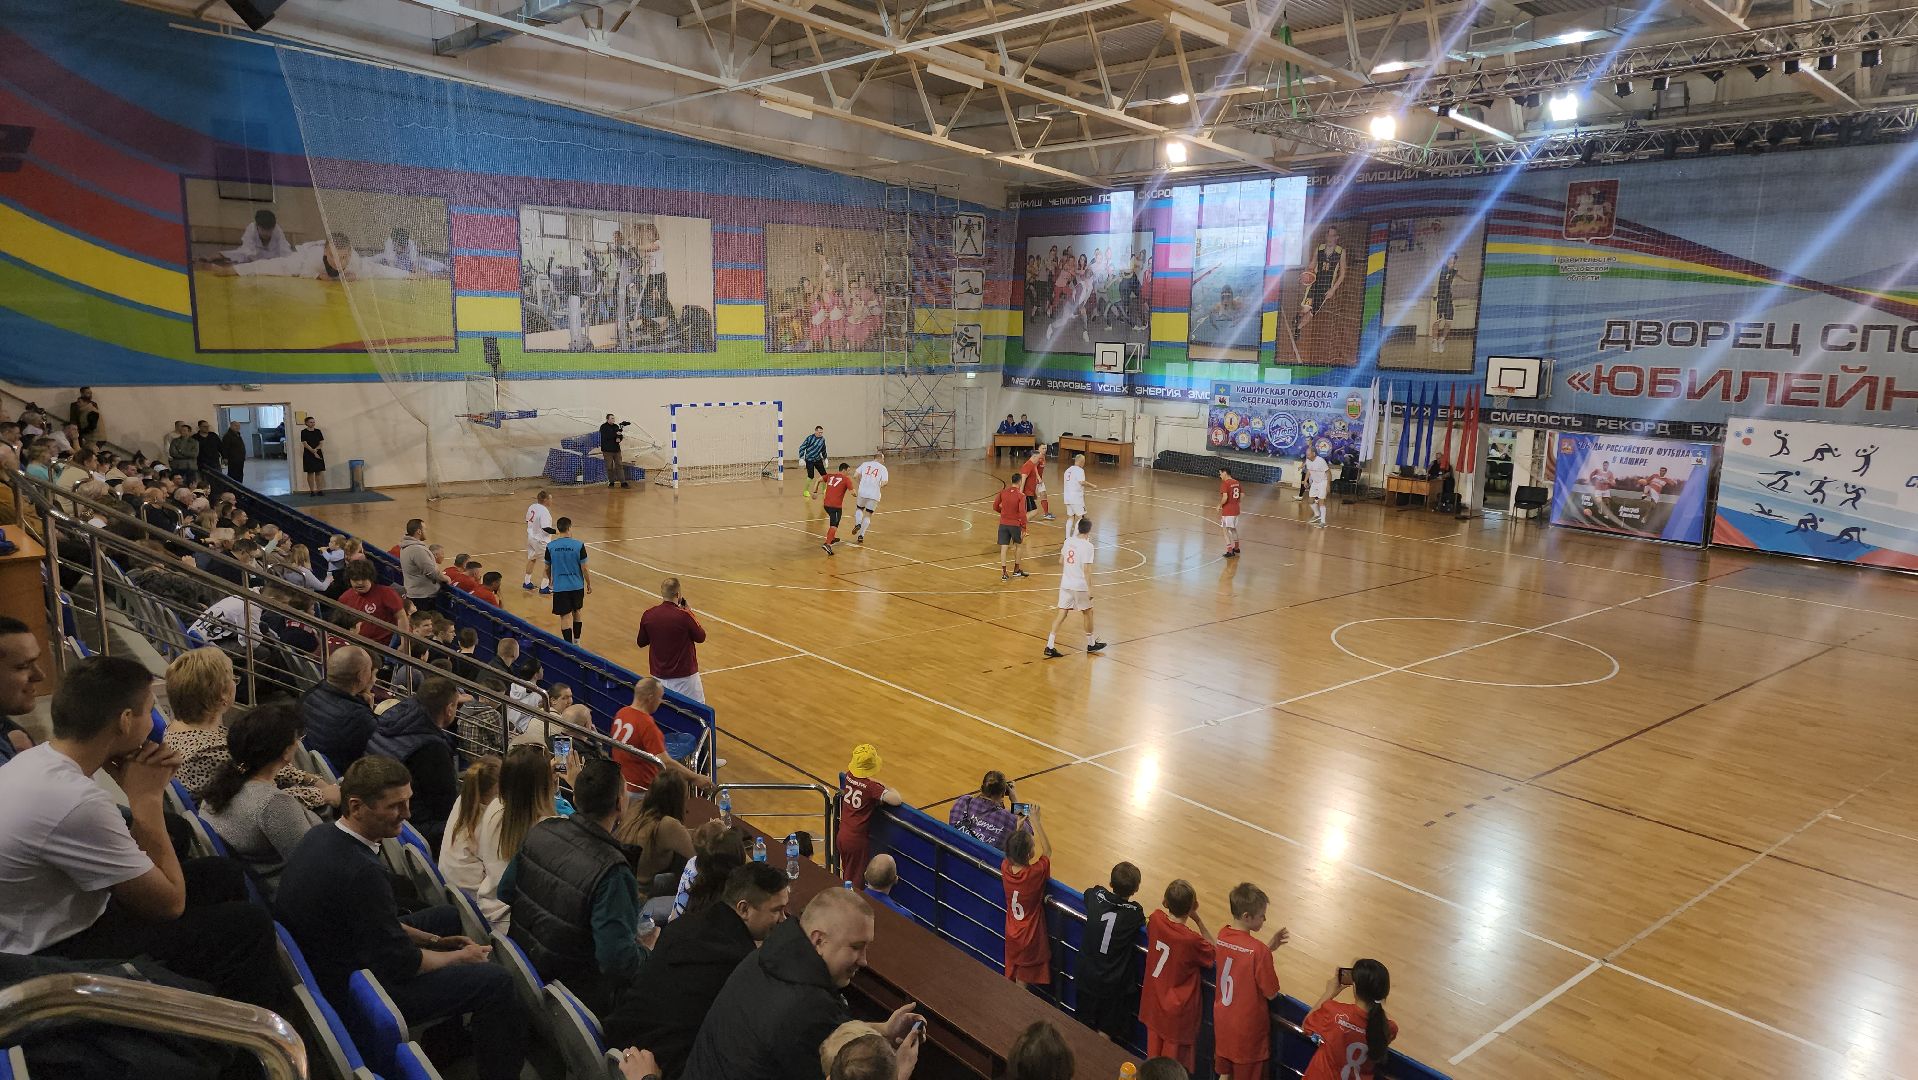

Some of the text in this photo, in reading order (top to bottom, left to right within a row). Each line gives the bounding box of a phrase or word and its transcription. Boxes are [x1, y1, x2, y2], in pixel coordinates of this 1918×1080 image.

[1009, 199, 1042, 209] ФИНИШ
[1048, 195, 1093, 206] ЧЕМПИОН
[1355, 169, 1420, 184] ЭМОЦИИ
[1598, 318, 1802, 356] ДВОРЕЦ
[1236, 386, 1338, 399] КАШИРСКАЯ ГОРОДСКАЯ
[1240, 396, 1331, 409] ФЕДЕРАЦИЯ ФУТБОЛА
[1011, 376, 1041, 387] МЕЧТА
[1046, 380, 1092, 391] ЗДОРОВЬЕ
[1097, 383, 1129, 394] УСПЕХ
[1135, 386, 1181, 398] ЭНЕРГИЯ
[1490, 411, 1582, 427] СМЕЛОСТЬ
[1596, 418, 1671, 435] РЕКОРД
[1605, 443, 1654, 456] РОССИЙСКОГО
[1656, 446, 1691, 458] ФУТБОЛА
[865, 465, 879, 478] 14
[1619, 456, 1649, 467] КАШИРЕ
[827, 475, 843, 488] 17
[1232, 487, 1240, 499] 8
[528, 510, 536, 523] 2
[1067, 550, 1075, 564] 8
[843, 784, 863, 809] 26
[1011, 890, 1025, 921] 6
[1099, 911, 1118, 955] 1
[1152, 939, 1171, 978] 7
[1220, 956, 1234, 1007] 6
[1340, 1042, 1369, 1080] 8
